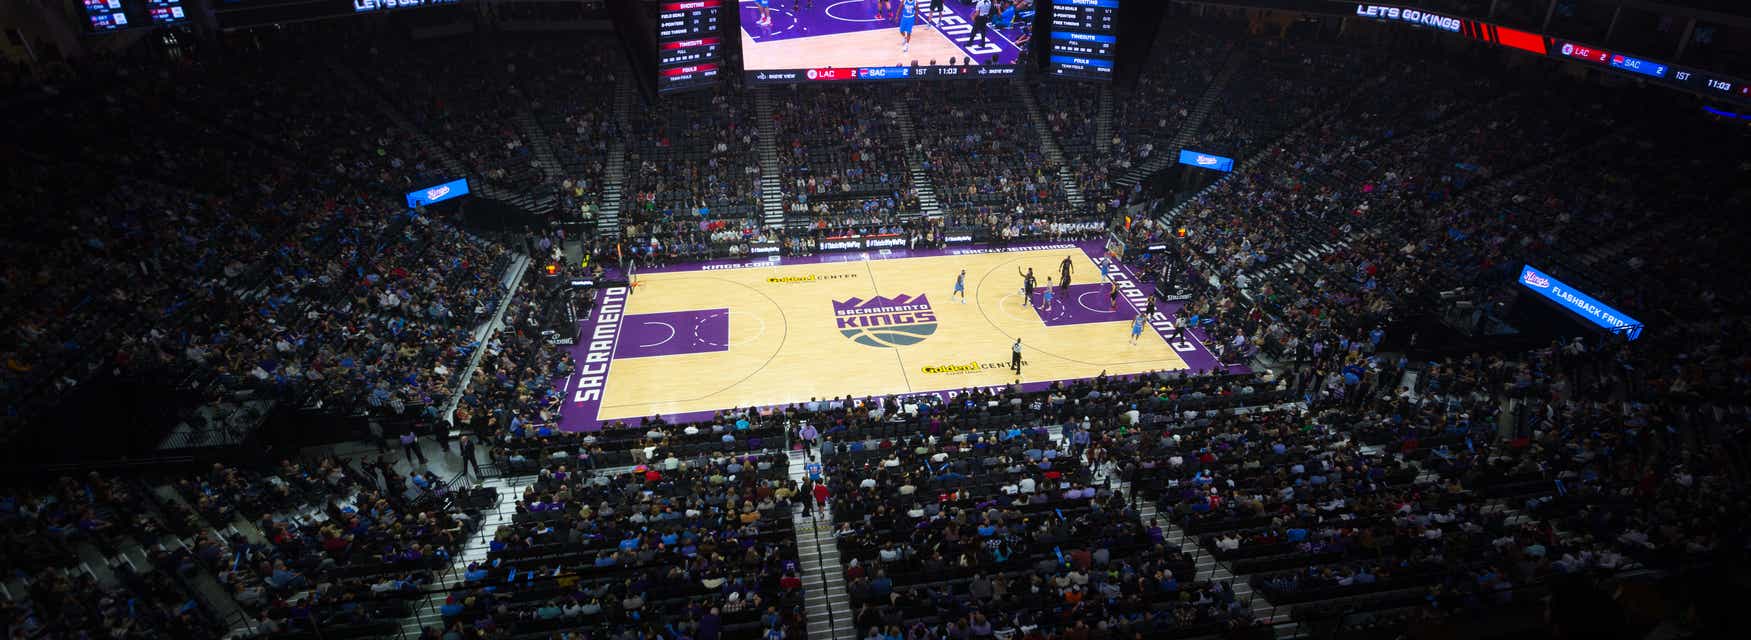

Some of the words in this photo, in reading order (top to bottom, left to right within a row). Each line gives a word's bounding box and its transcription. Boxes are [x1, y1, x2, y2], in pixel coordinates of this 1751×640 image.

[1357, 5, 1400, 18] LETS
[1402, 9, 1420, 21] GO
[1421, 13, 1461, 30] KINGS
[819, 70, 834, 78] LAC
[869, 69, 886, 77] SAC
[1574, 48, 1589, 57] LAC
[1600, 53, 1606, 61] 2
[1624, 59, 1641, 69] SAC
[1656, 66, 1663, 74] 2
[1675, 71, 1690, 81] 1ST
[1707, 79, 1731, 91] 11:03
[1523, 270, 1549, 288] Kings
[837, 304, 928, 316] SACRAMENTO
[1552, 286, 1601, 318] FLASHBACK
[836, 311, 937, 329] KINGS
[574, 287, 627, 402] SACRAMENTO
[981, 361, 1028, 370] CENTR
